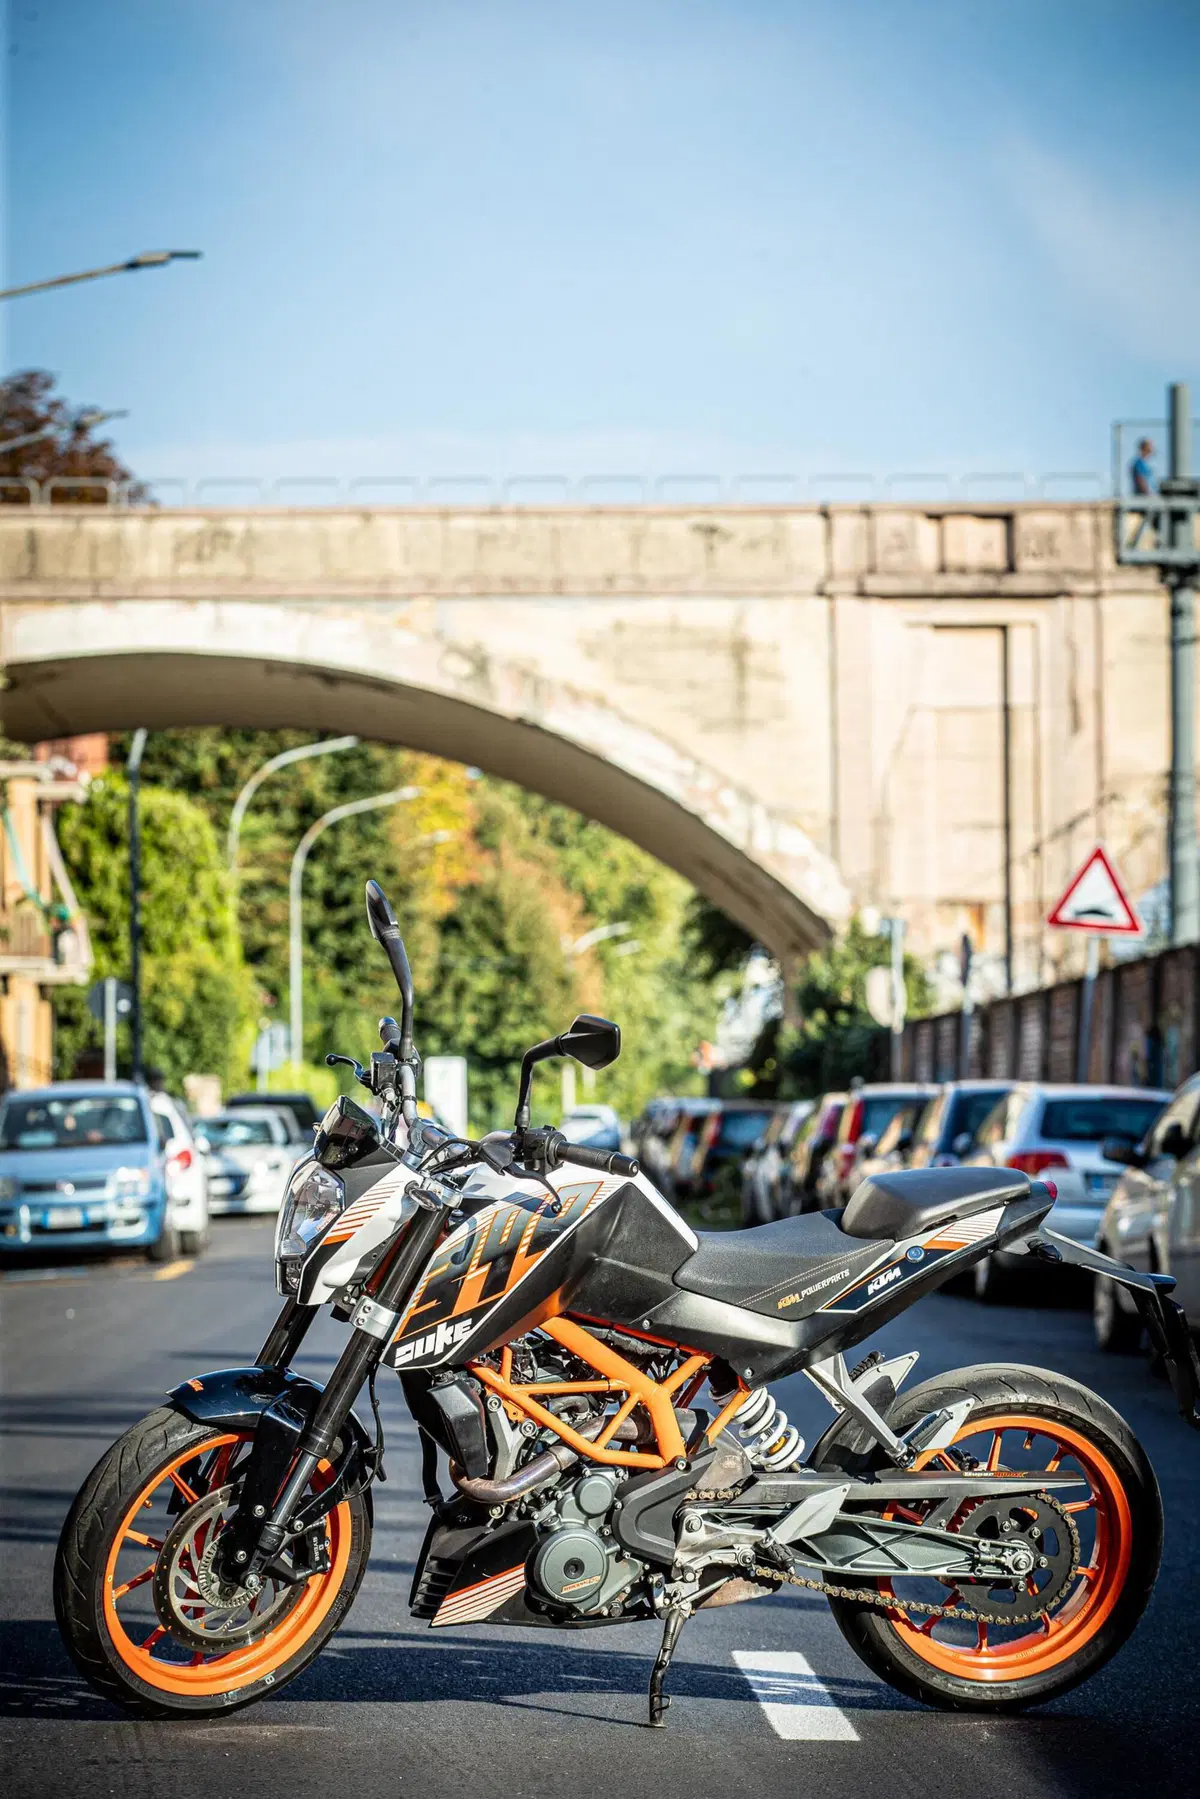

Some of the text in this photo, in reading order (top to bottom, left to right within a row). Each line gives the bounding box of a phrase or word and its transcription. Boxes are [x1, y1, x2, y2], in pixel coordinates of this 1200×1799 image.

[777, 1268, 850, 1309] KTM POWERPARTS
[868, 1267, 901, 1295] KTM
